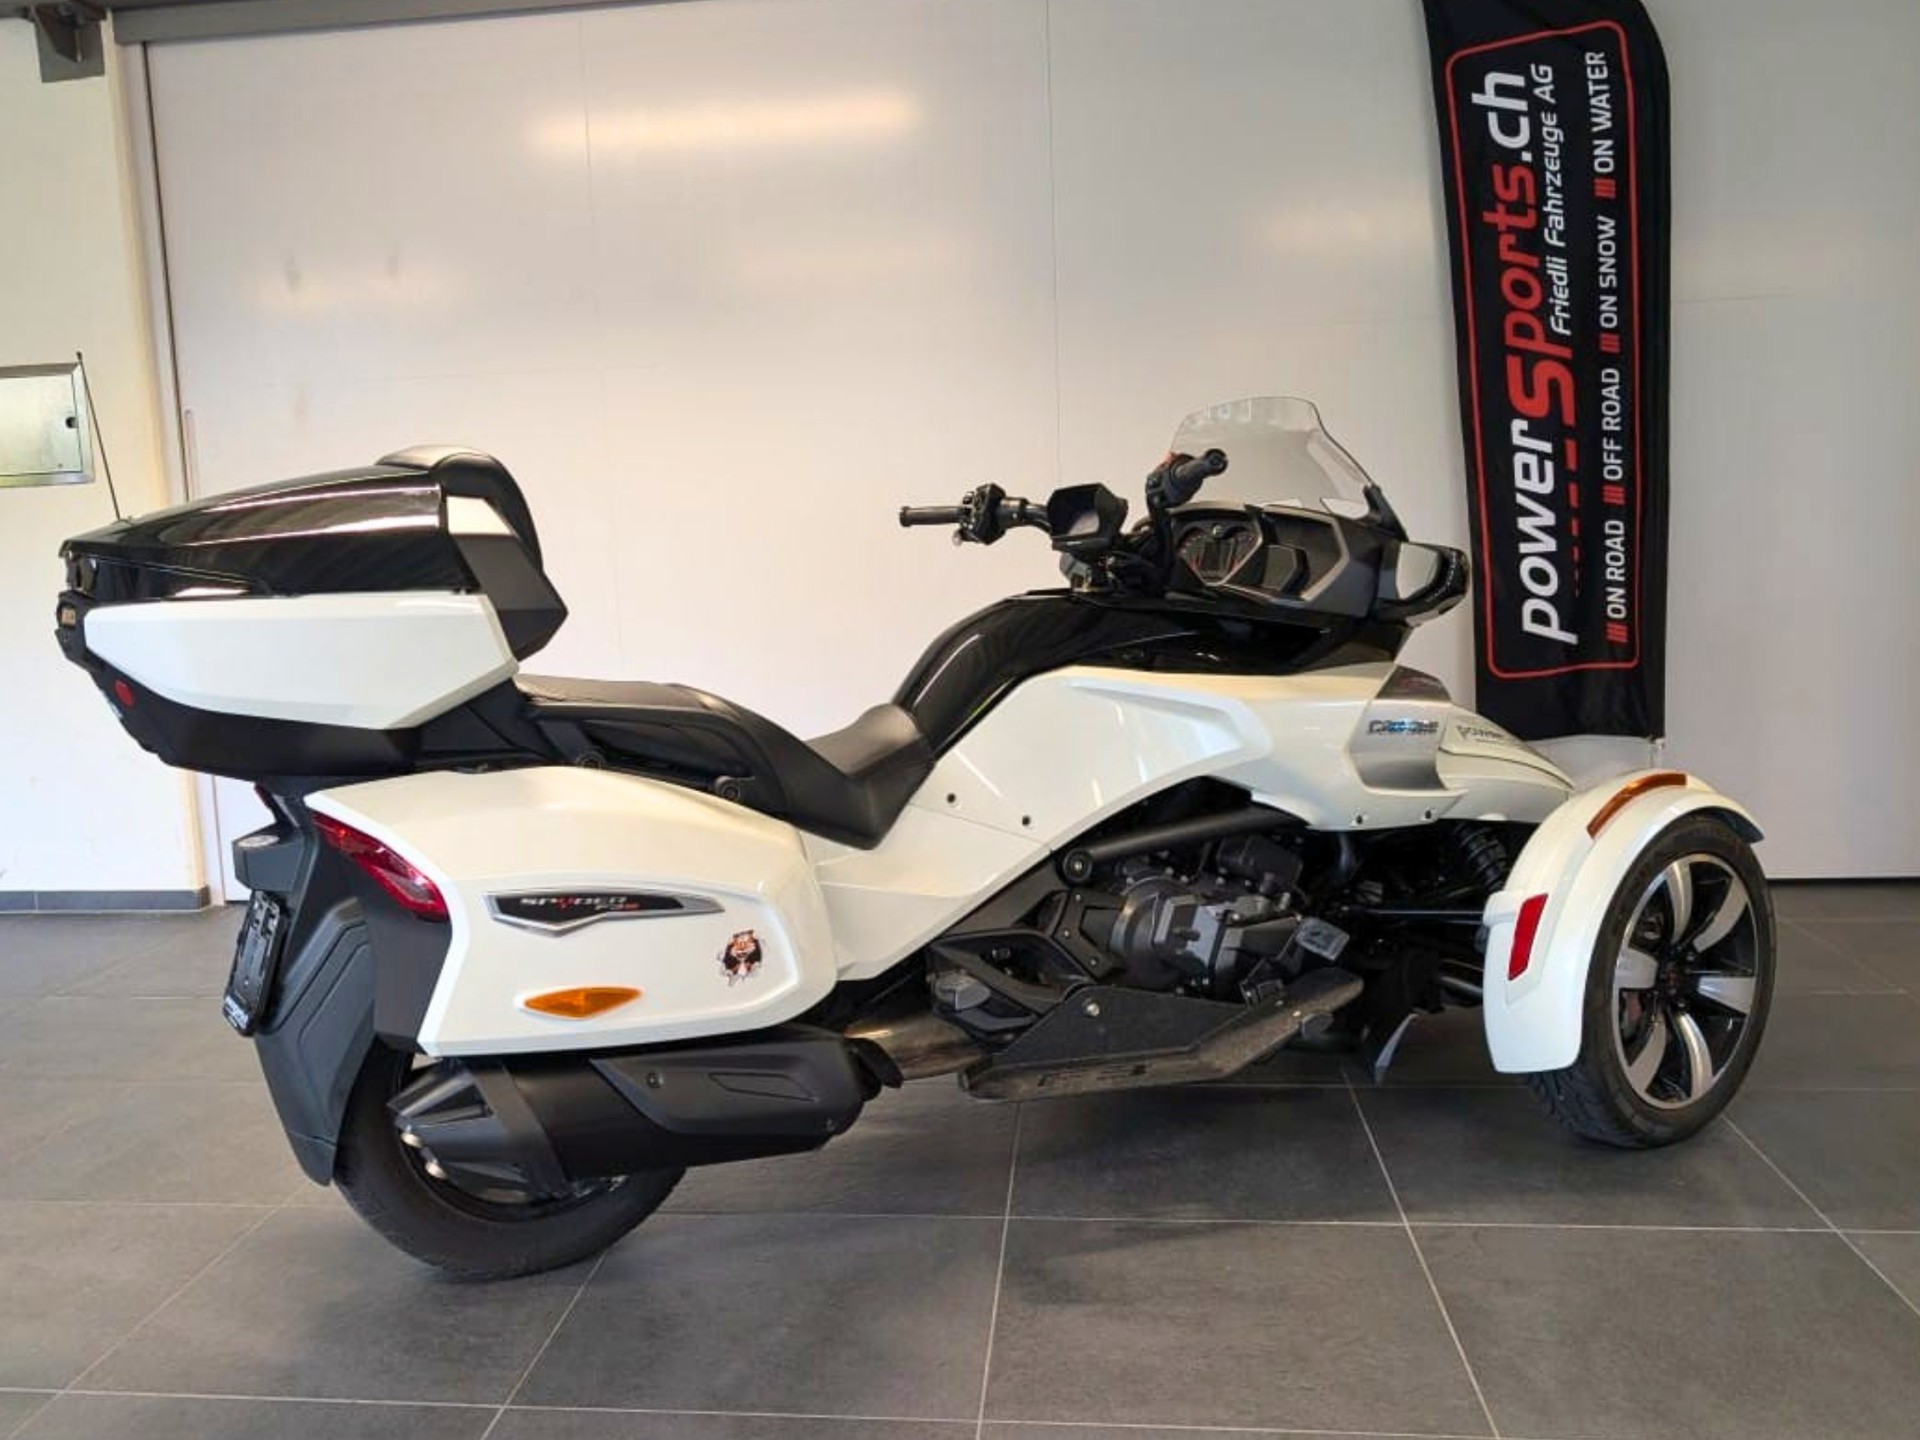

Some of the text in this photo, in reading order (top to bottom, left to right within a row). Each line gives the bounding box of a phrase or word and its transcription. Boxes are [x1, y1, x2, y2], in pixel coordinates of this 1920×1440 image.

[1584, 51, 1616, 174] ON WATER
[1530, 63, 1573, 336] Friedli Fahrzeuge AG
[1596, 214, 1619, 330] ON SNOW
[1471, 71, 1578, 646] powerSports.ch
[1601, 367, 1624, 482] OFF ROAD
[1604, 518, 1628, 620] ON ROAD
